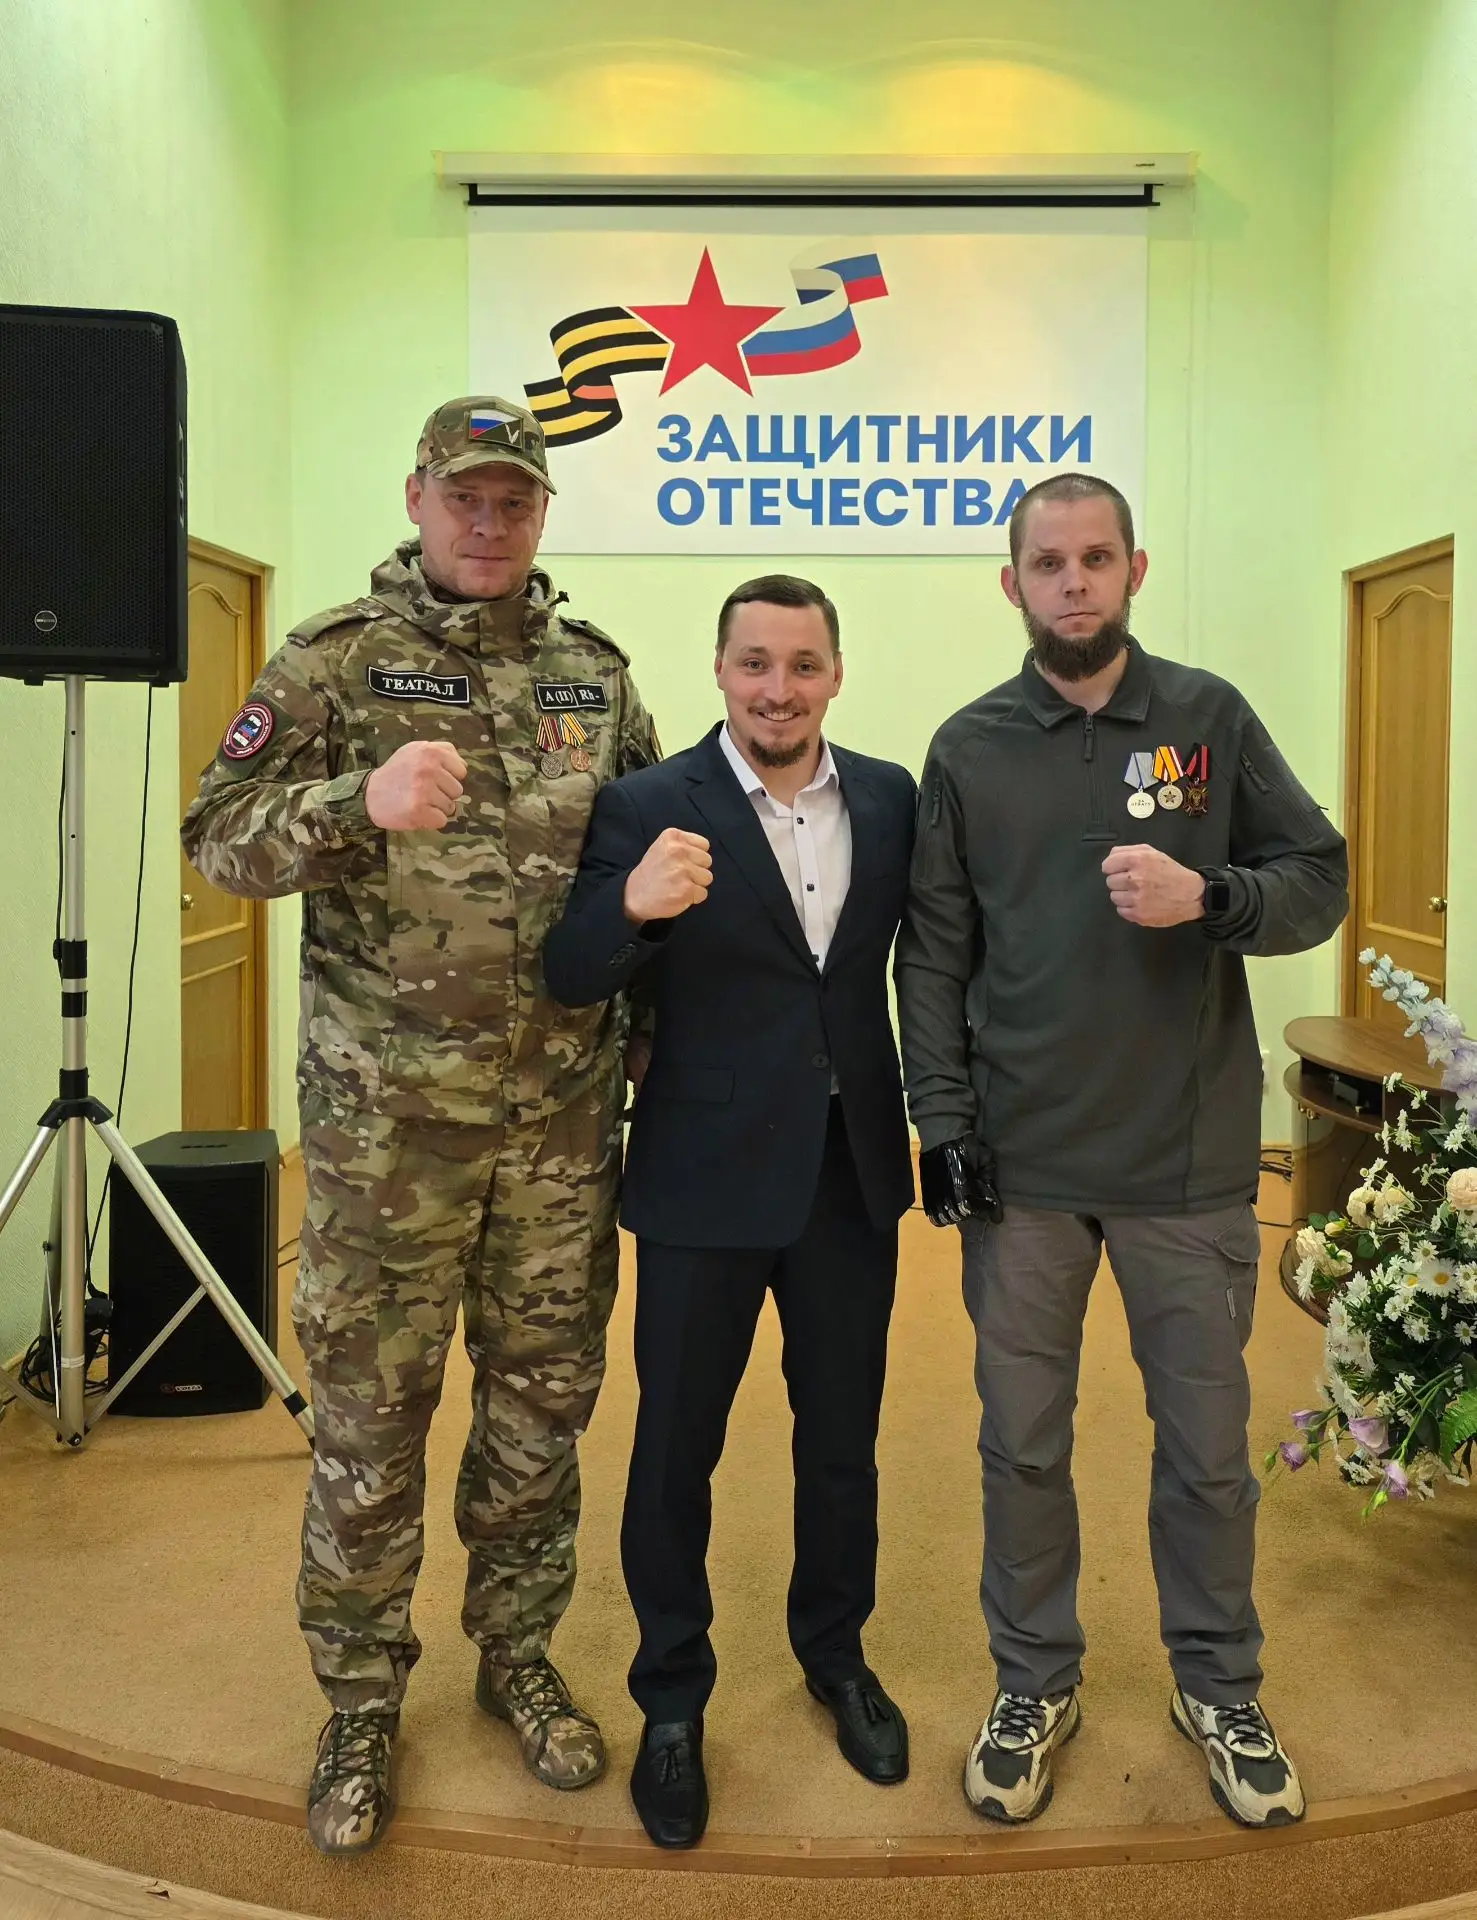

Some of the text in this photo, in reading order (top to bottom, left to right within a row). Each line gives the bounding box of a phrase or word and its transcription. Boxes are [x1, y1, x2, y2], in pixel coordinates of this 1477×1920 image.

[657, 413, 1093, 469] ЗАЩИТНИКИ
[656, 477, 1028, 526] ОТЕЧЕСТВА
[382, 677, 455, 696] ТЕАТРАЛ
